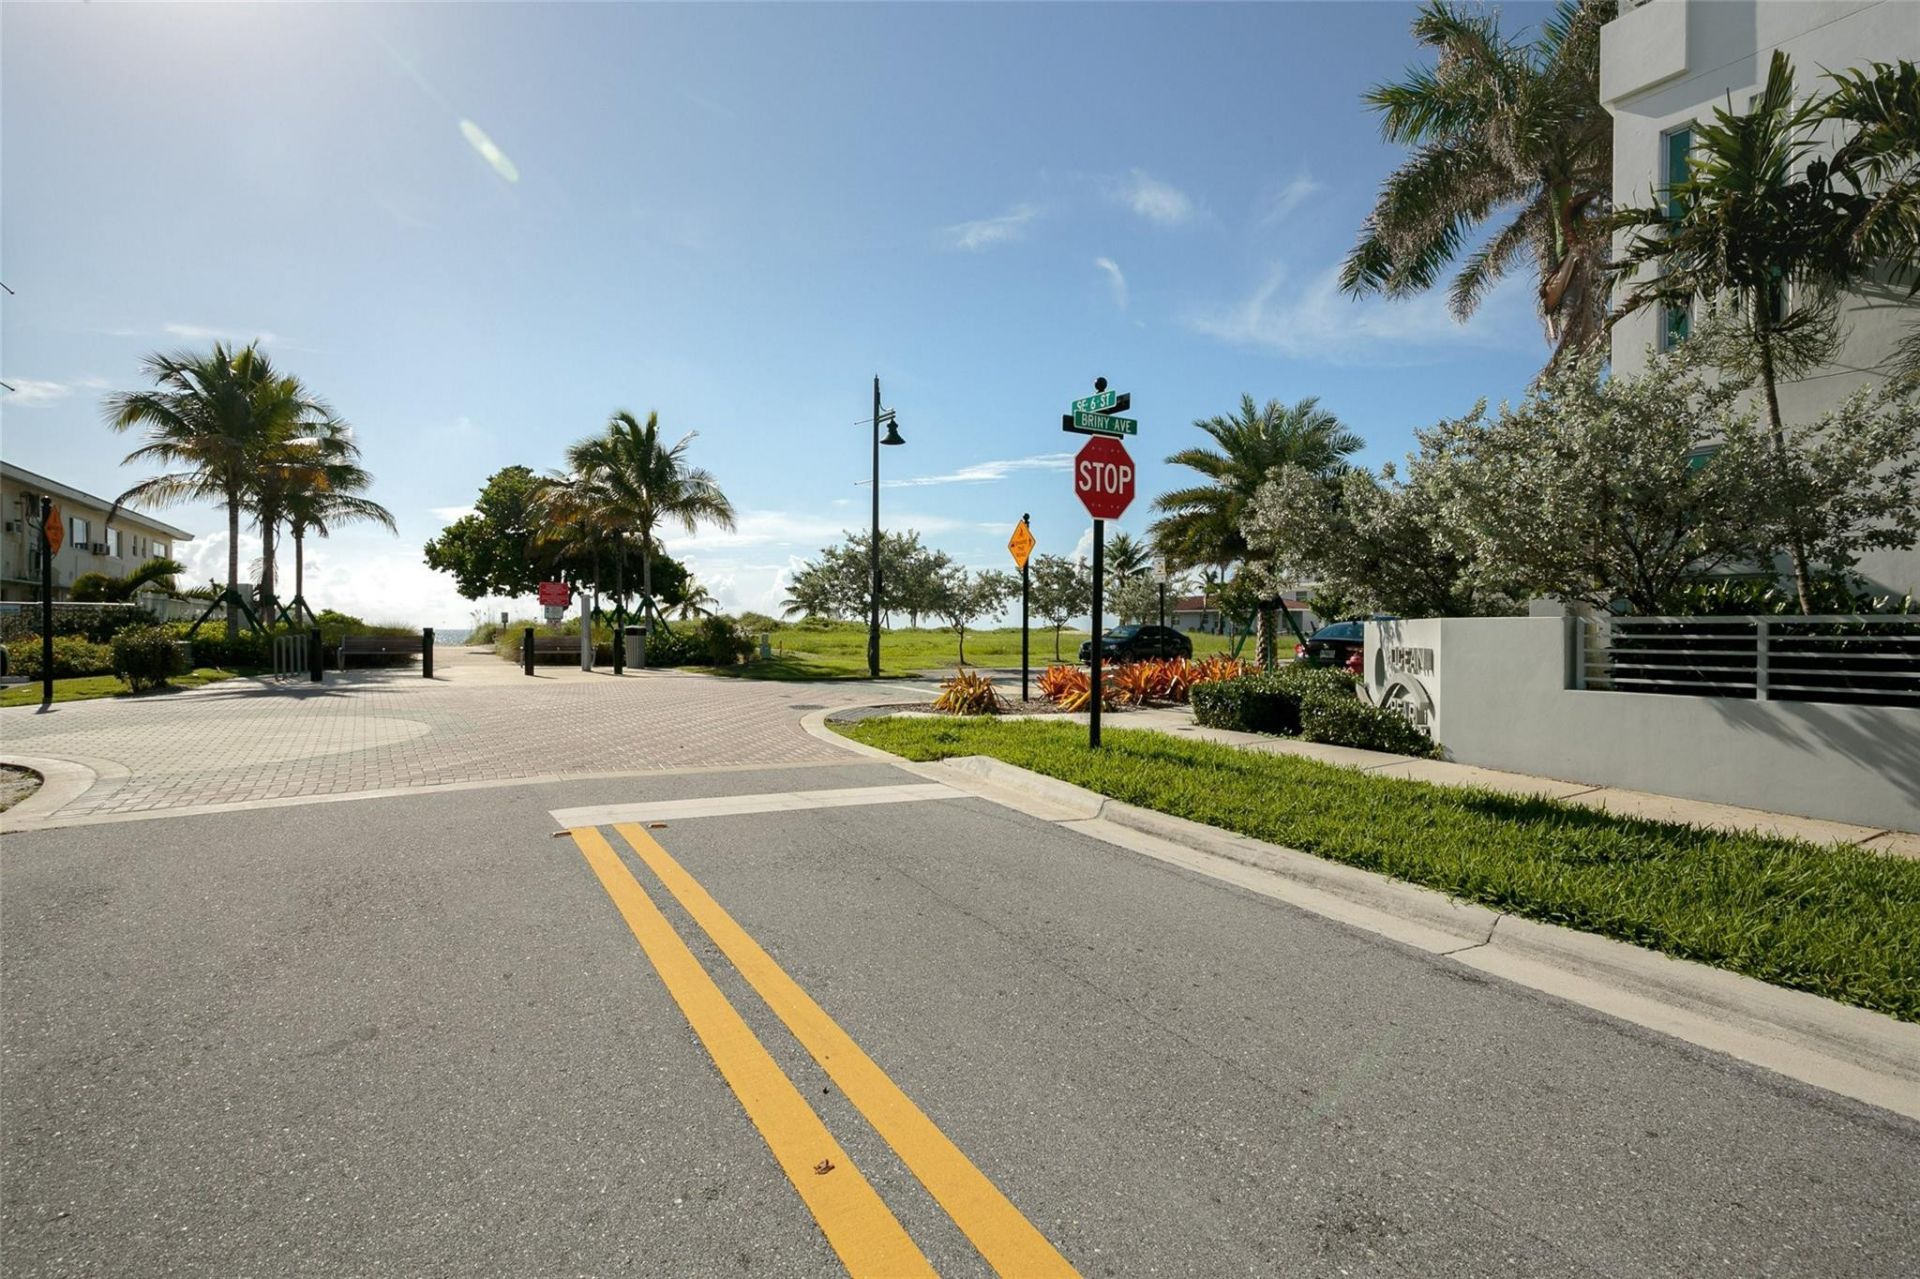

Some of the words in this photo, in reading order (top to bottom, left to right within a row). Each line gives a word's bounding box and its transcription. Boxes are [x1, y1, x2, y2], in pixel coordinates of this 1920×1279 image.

[1077, 400, 1087, 413] SE
[1090, 398, 1098, 410] 6
[1101, 393, 1111, 407] ST
[1082, 414, 1110, 428] BRINY
[1114, 419, 1131, 433] AVE
[1079, 460, 1132, 494] STOP
